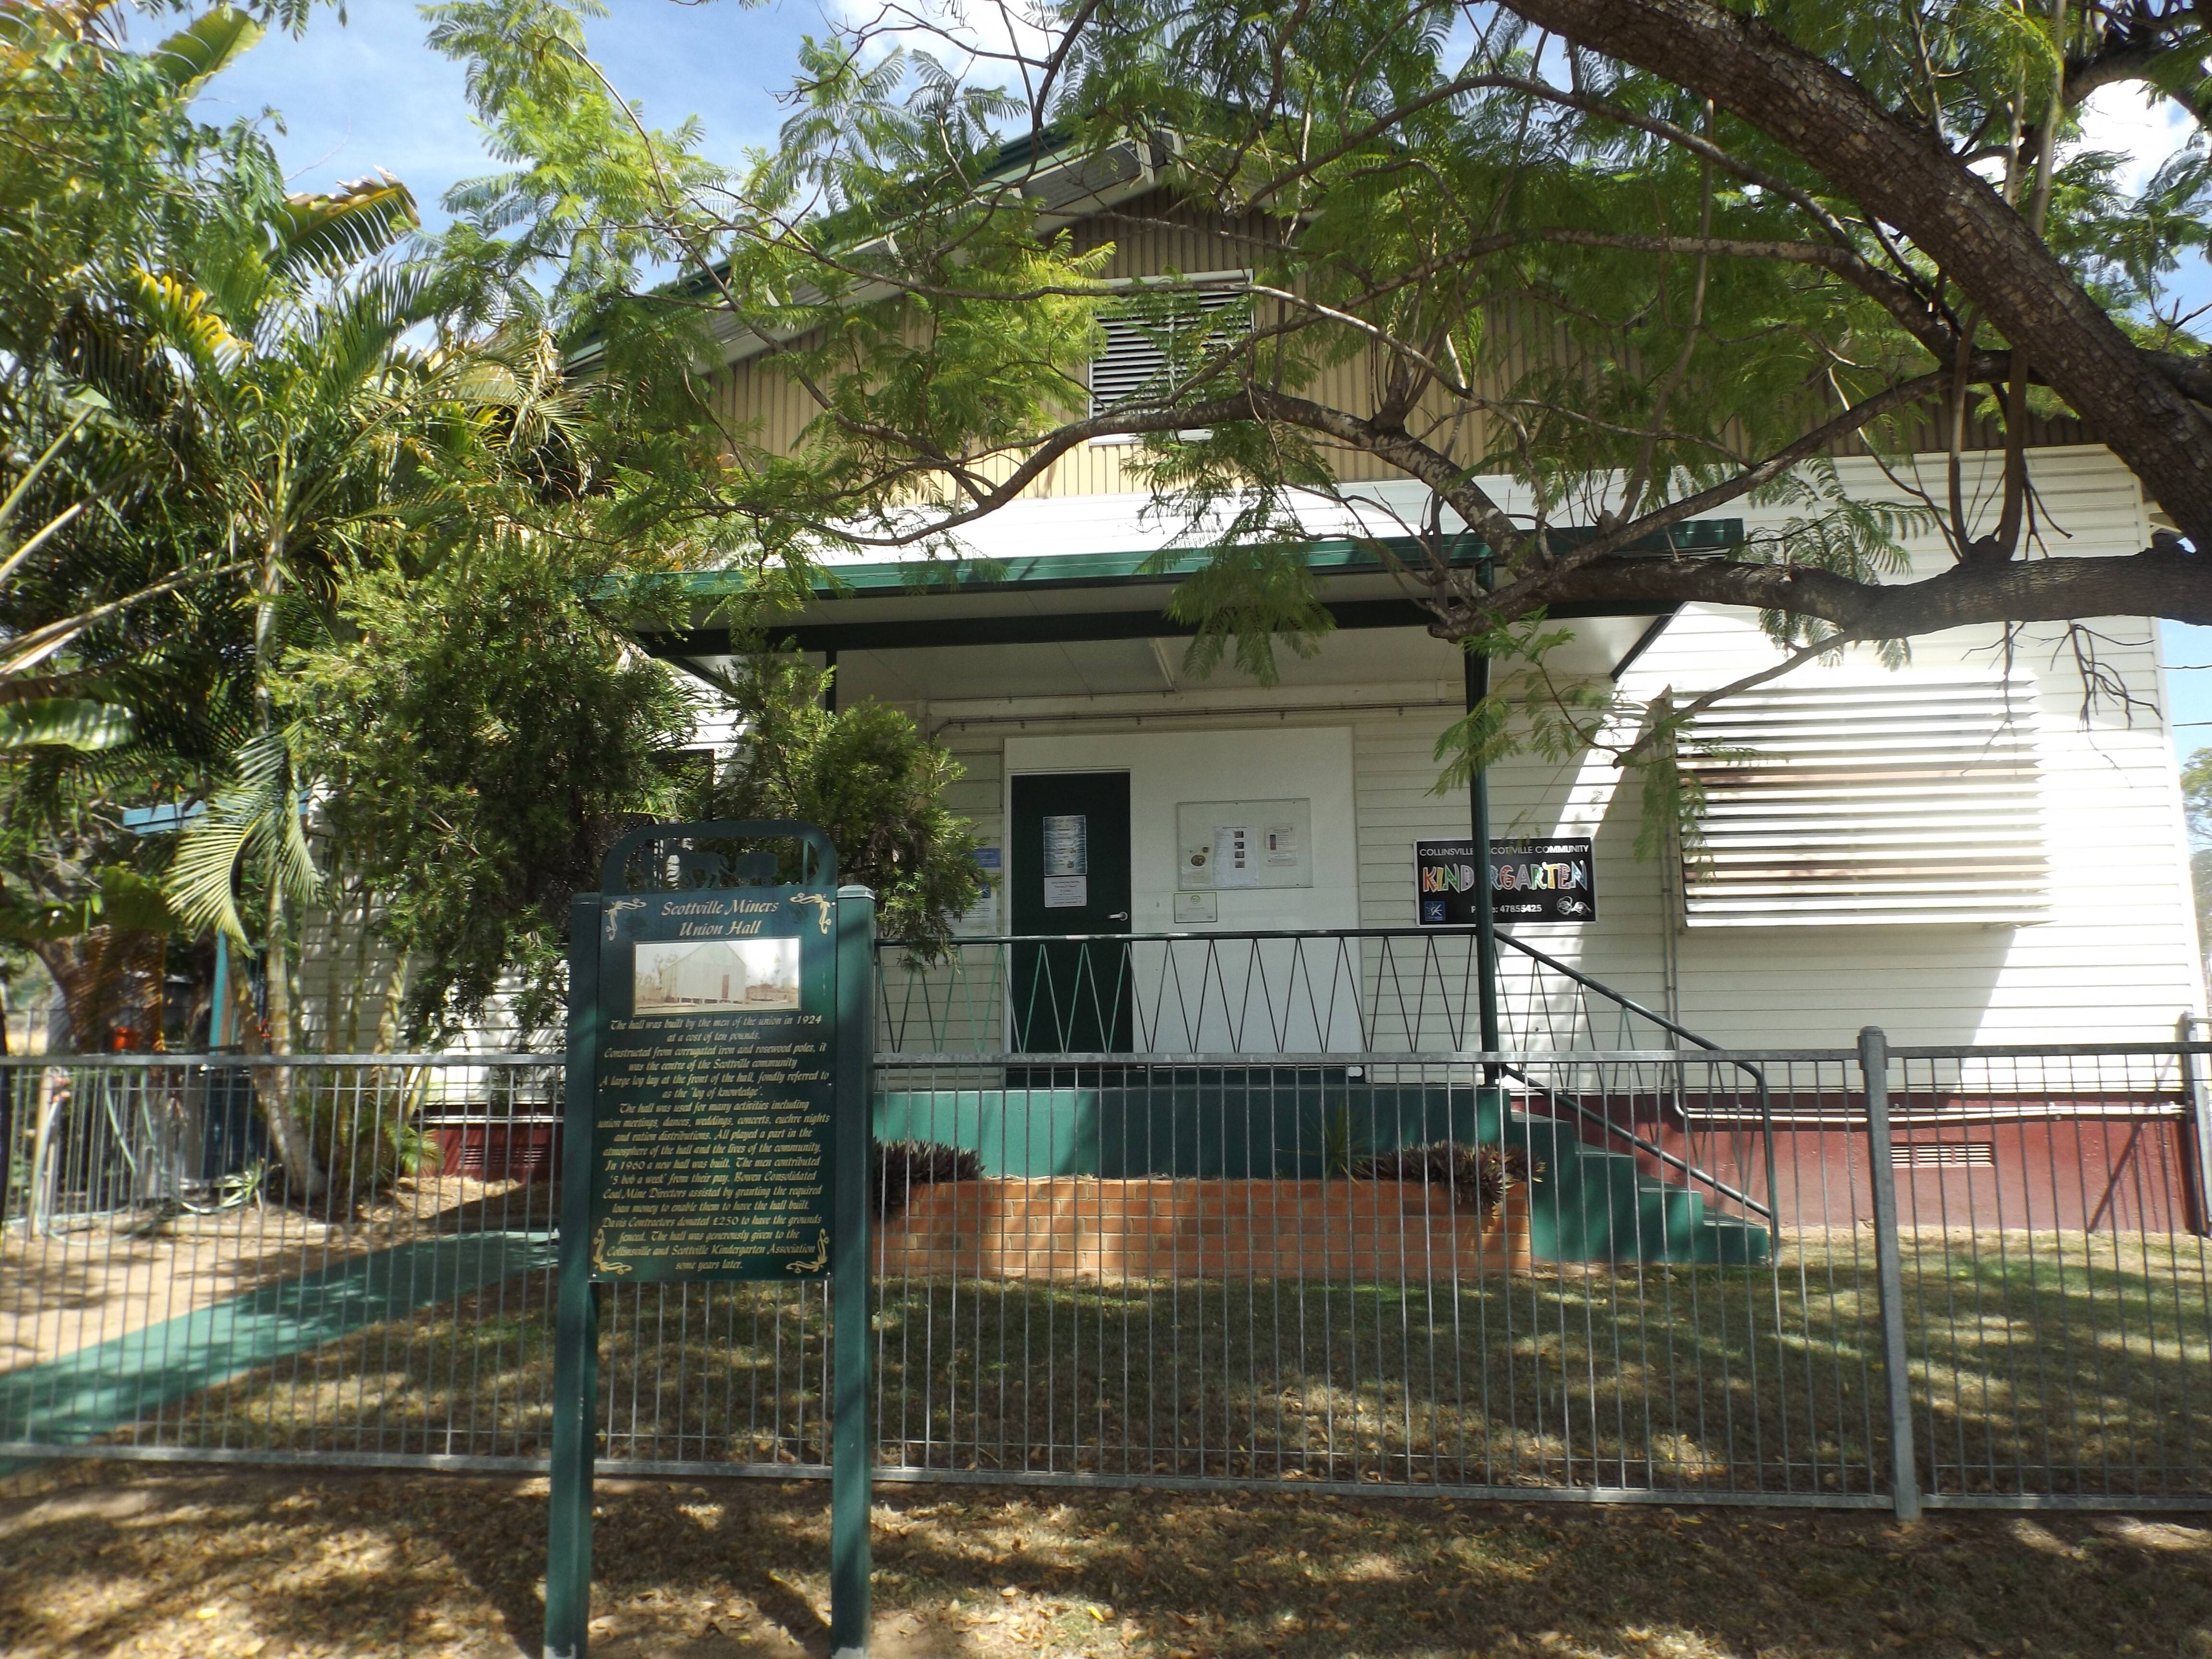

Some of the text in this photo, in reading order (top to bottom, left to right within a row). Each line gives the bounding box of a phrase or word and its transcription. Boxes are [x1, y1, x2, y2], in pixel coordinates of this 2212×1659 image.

[1419, 845, 1589, 856] COLLINSVILLE COTVILLE COMMUNITY
[1423, 860, 1587, 894] KINDRGARTEN
[661, 899, 780, 915] Scottville Miners
[1500, 904, 1542, 913] 47855425
[679, 920, 762, 937] Union Hall
[611, 1020, 626, 1030] The
[628, 1020, 645, 1029] hall
[664, 1019, 683, 1028] built
[685, 1018, 696, 1030] by
[697, 1018, 711, 1027] the
[732, 1016, 742, 1028] of
[743, 1016, 757, 1025] the
[757, 1016, 781, 1025] union
[784, 1015, 793, 1024] in
[797, 1015, 821, 1024] 1924
[667, 1034, 676, 1042] at
[685, 1033, 702, 1041] cost
[703, 1031, 713, 1043] of
[728, 1030, 760, 1042] pounds.
[604, 1047, 652, 1058] Constructed
[652, 1046, 673, 1058] from
[674, 1045, 717, 1058] corrugated
[718, 1046, 735, 1054] iron
[737, 1044, 754, 1054] and
[819, 1043, 826, 1051] it
[646, 1061, 660, 1070] the
[661, 1061, 685, 1070] centre
[686, 1059, 697, 1071] of
[697, 1059, 711, 1069] the
[713, 1058, 750, 1069] Scottville
[752, 1058, 797, 1069] community
[599, 1076, 607, 1086] A
[611, 1076, 631, 1087] large
[632, 1075, 644, 1087] log
[646, 1075, 660, 1087] lay
[661, 1075, 670, 1084] at
[673, 1074, 686, 1083] the
[686, 1074, 708, 1085] front
[710, 1073, 721, 1085] of
[721, 1072, 735, 1082] the
[757, 1071, 785, 1083] fondly
[787, 1070, 818, 1082] referred
[820, 1071, 829, 1079] to
[674, 1088, 688, 1097] the
[707, 1087, 717, 1099] of
[620, 1103, 636, 1113] The
[637, 1103, 654, 1112] hall
[673, 1102, 693, 1112] used
[693, 1102, 707, 1114] for
[708, 1104, 732, 1113] many
[733, 1101, 769, 1110] activities
[771, 1099, 809, 1111] including
[597, 1118, 621, 1128] union
[803, 1113, 830, 1125] nights
[614, 1132, 631, 1141] and
[713, 1129, 730, 1140] All
[730, 1129, 758, 1141] played
[767, 1129, 785, 1140] part
[787, 1128, 796, 1137] in
[799, 1127, 812, 1137] the
[649, 1145, 660, 1157] of
[661, 1145, 674, 1154] the
[675, 1145, 693, 1154] hall
[693, 1144, 711, 1154] and
[712, 1143, 726, 1154] the
[727, 1143, 746, 1153] lives
[747, 1143, 757, 1155] of
[758, 1142, 772, 1152] the
[774, 1142, 821, 1154] community.
[605, 1160, 616, 1171] In
[620, 1161, 645, 1170] 1960
[673, 1159, 690, 1168] hall
[709, 1158, 730, 1168] built.
[736, 1157, 753, 1167] The
[774, 1156, 820, 1166] contributed
[668, 1173, 689, 1185] from
[691, 1173, 711, 1182] their
[712, 1175, 730, 1184] pay.
[734, 1172, 762, 1181] Bowen
[764, 1170, 817, 1181] Consolidated
[603, 1189, 622, 1199] Coal
[621, 1188, 647, 1199] Mine
[649, 1188, 686, 1198] Directors
[688, 1187, 721, 1197] assisted
[723, 1187, 733, 1199] by
[773, 1186, 787, 1195] the
[789, 1185, 822, 1197] required
[612, 1200, 809, 1214] loan money to enable them to have the hall built.
[601, 1214, 822, 1227] Davis Contractors donated £250 to have the grounds
[651, 1231, 668, 1241] The
[669, 1231, 686, 1240] hall
[751, 1230, 773, 1241] given
[775, 1230, 784, 1238] to
[786, 1229, 800, 1238] the
[606, 1243, 816, 1256] Collinsville and Scottville Kindergarten Association
[697, 1262, 720, 1271] years
[722, 1259, 742, 1268] later.
